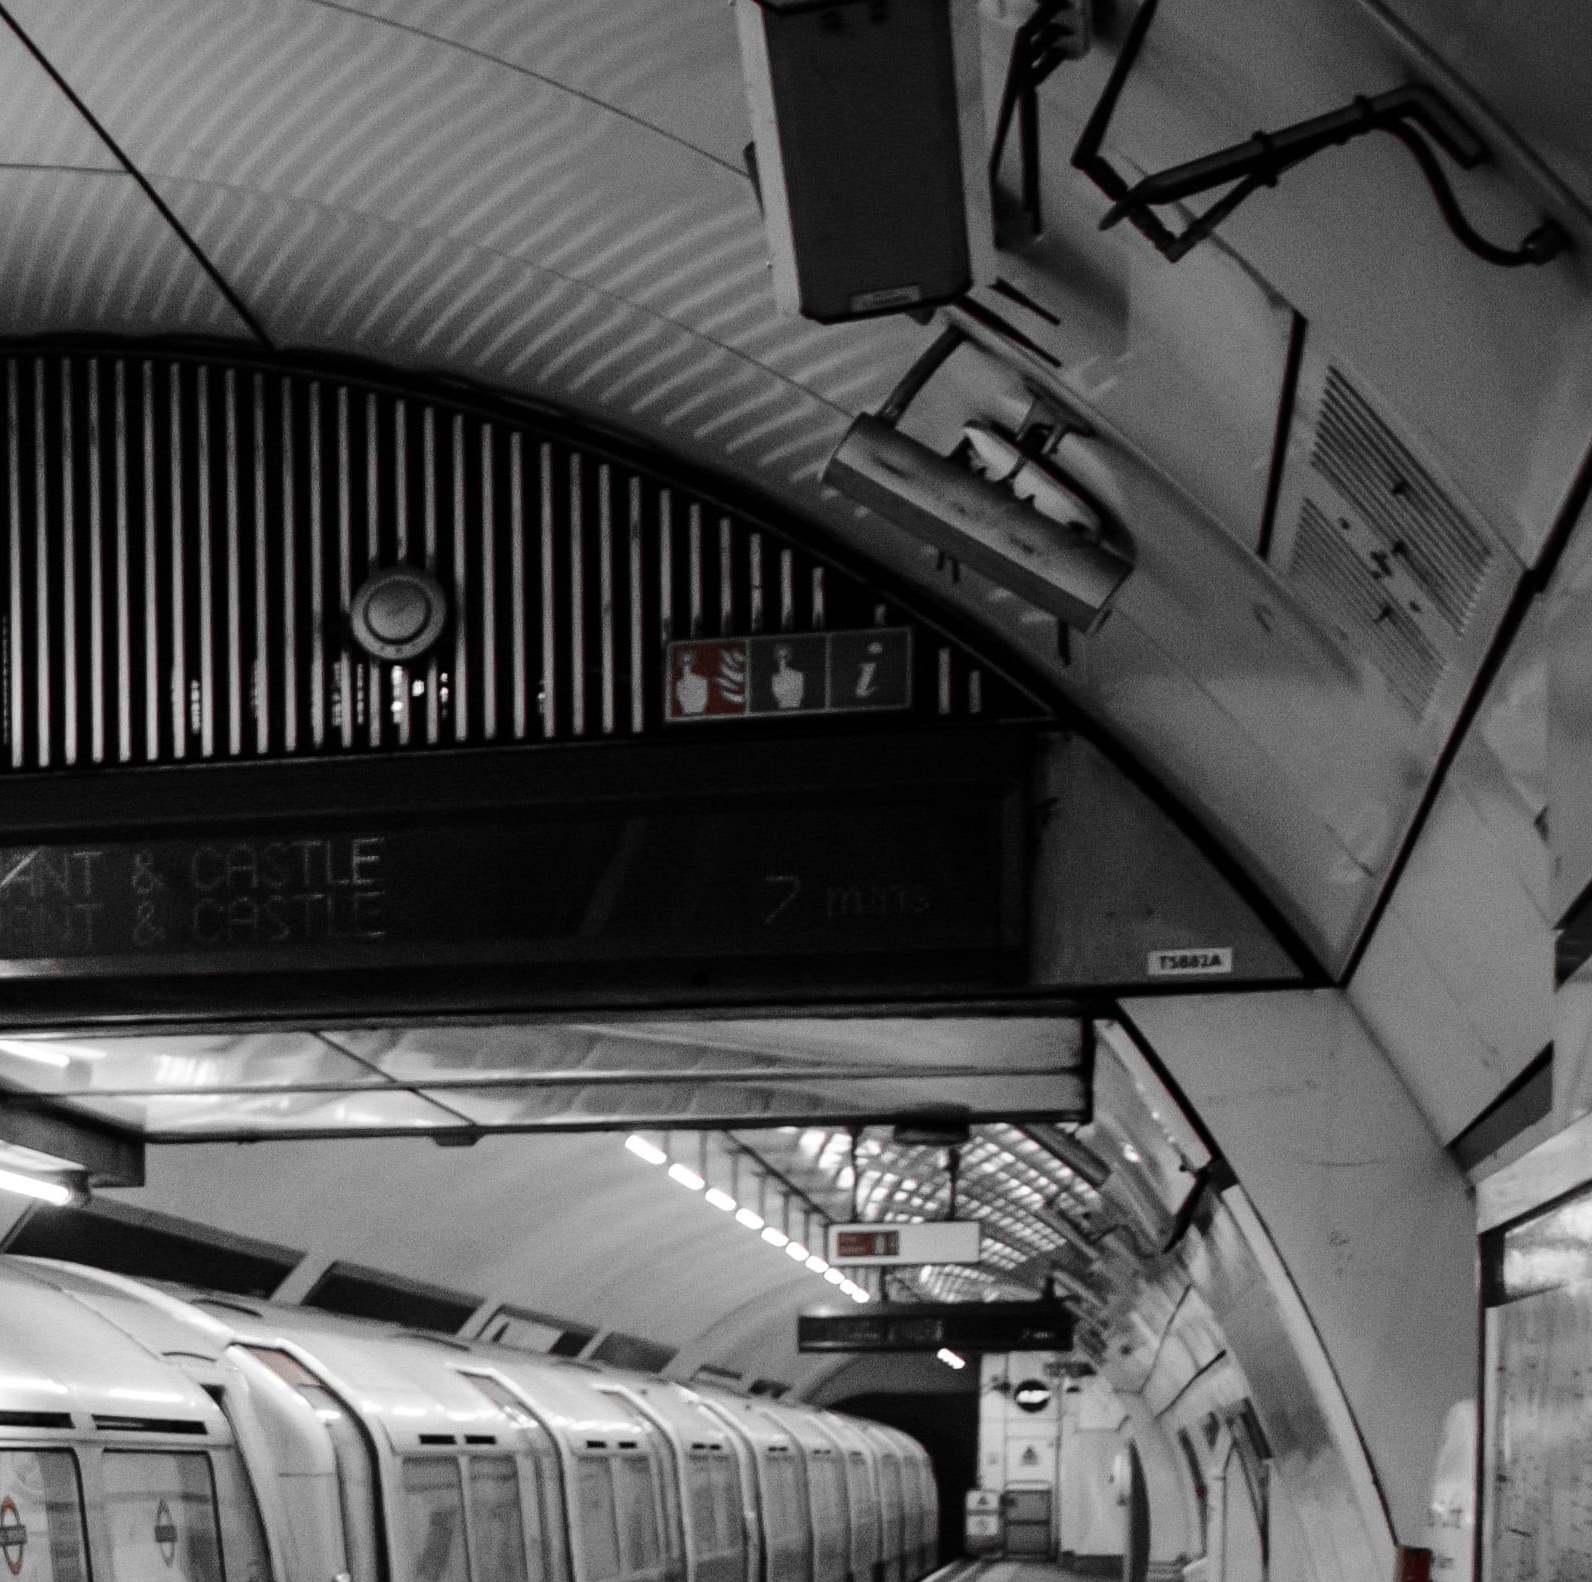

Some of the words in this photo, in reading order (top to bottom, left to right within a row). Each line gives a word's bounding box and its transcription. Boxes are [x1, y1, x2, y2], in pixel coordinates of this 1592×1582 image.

[130, 850, 164, 896] &
[191, 836, 386, 891] CASTLE
[132, 900, 165, 947] &
[192, 891, 386, 942] CASTLE
